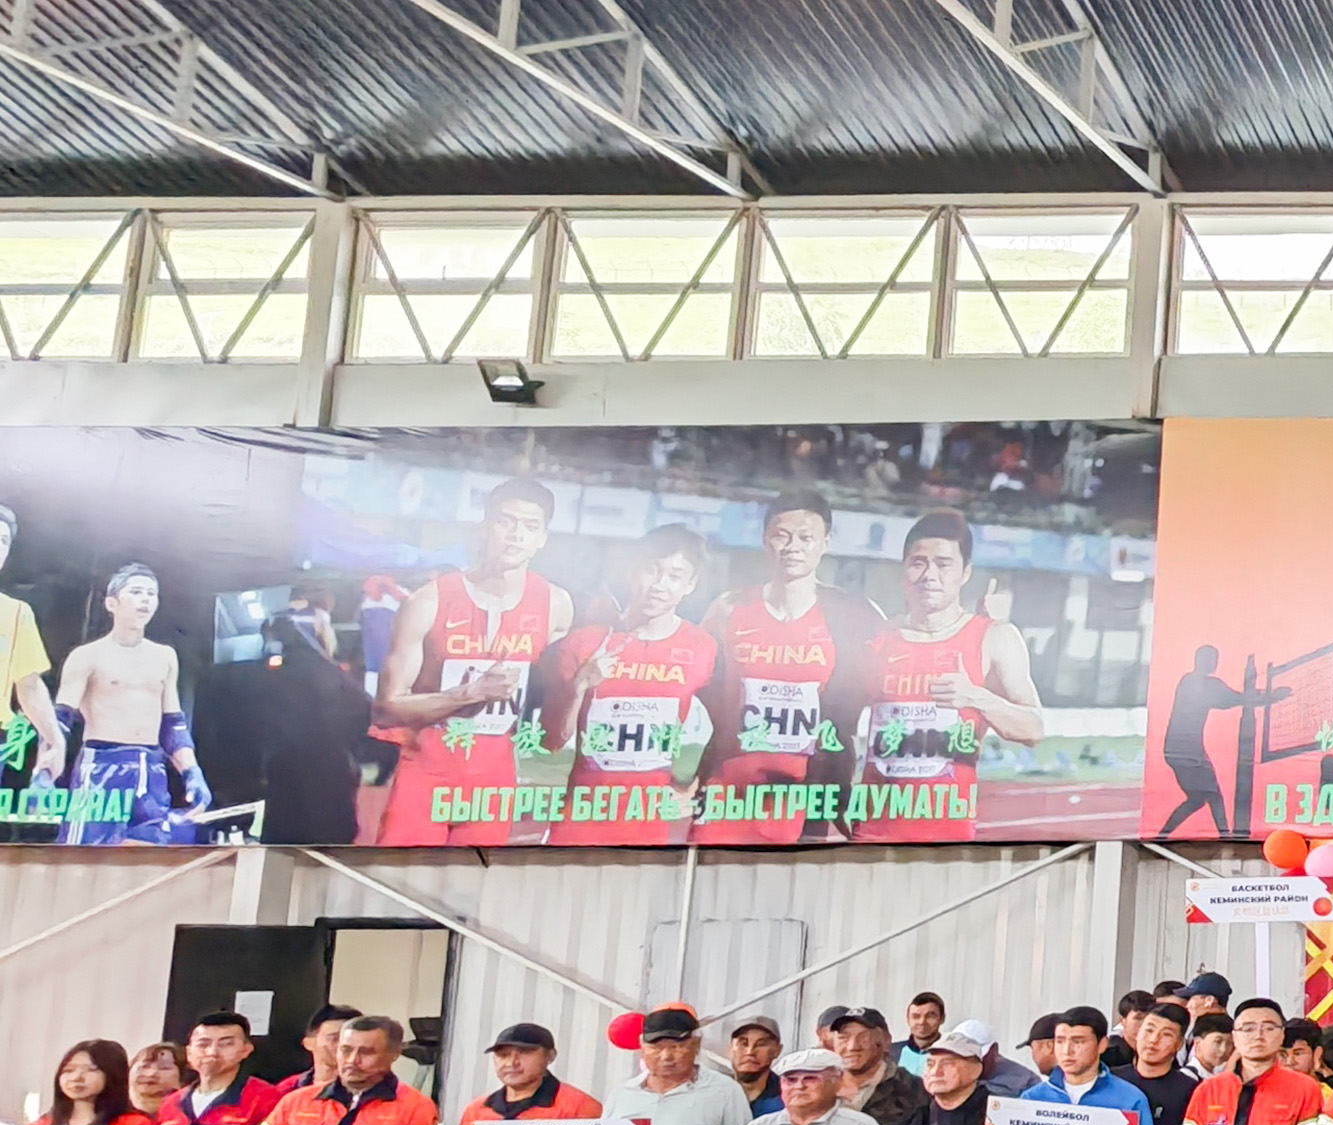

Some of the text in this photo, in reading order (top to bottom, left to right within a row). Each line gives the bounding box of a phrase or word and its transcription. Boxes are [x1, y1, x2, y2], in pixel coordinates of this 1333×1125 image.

[446, 633, 534, 656] CHINA
[735, 642, 827, 666] CHINA
[430, 783, 978, 823] БЫСТРЕЕ БЕГАТЬ БЫСТРЕЕ ДУМАТЬ!
[1264, 783, 1288, 824] В
[1210, 894, 1309, 904] КЕМИНСКИЙ РАЙОН
[1231, 884, 1290, 892] БАСКЕТБОЛ
[1035, 1109, 1090, 1121] ВОЛЕЙБОЛ
